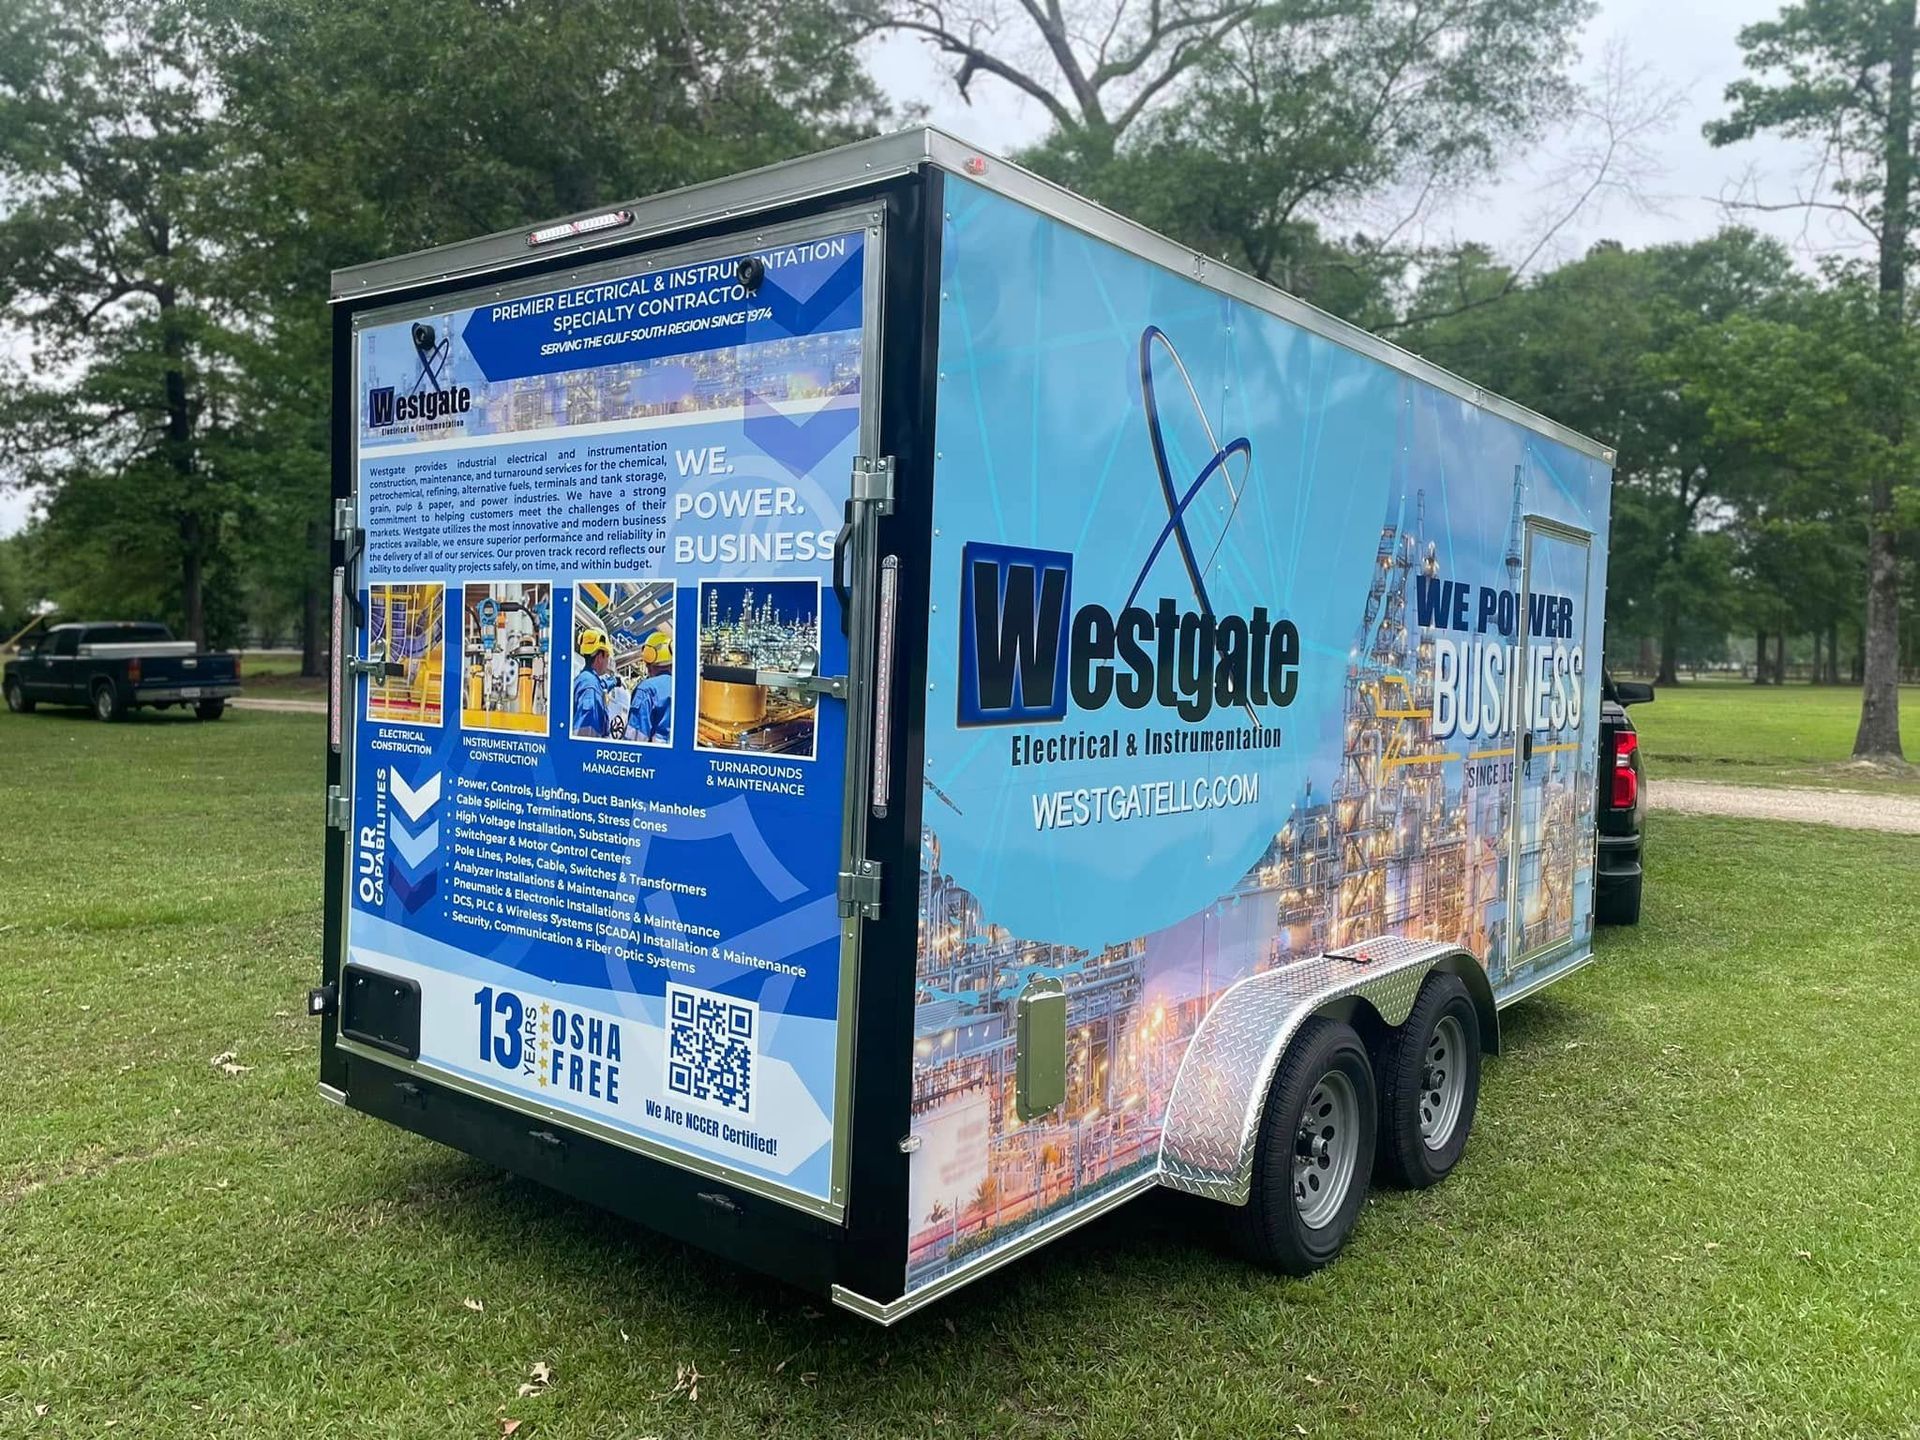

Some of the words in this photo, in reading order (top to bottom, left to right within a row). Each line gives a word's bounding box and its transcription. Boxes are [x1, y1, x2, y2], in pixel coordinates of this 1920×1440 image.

[492, 297, 554, 322] PREMIER
[558, 278, 650, 309] ELECTRICAL
[653, 275, 664, 291] &
[669, 238, 844, 288] INSTRUNTATION
[540, 338, 582, 355] SERVING
[582, 335, 602, 348] THE
[602, 330, 630, 345] GULF
[630, 324, 667, 341] SOUTH
[667, 317, 710, 335] REGION
[710, 311, 745, 327] SINCE
[746, 306, 772, 322] 1974
[553, 303, 634, 331] SPECIALTY
[371, 386, 471, 427] Westgate
[369, 466, 405, 477] Westgate
[414, 461, 447, 474] provides
[457, 455, 496, 468] industrial
[506, 451, 547, 464] electrical
[557, 448, 575, 459] and
[587, 440, 667, 456] instrumentation
[369, 476, 418, 488] construction,
[419, 473, 474, 484] maintenance,
[475, 469, 491, 480] and
[493, 465, 543, 478] turnaround
[544, 462, 582, 474] services
[584, 461, 597, 471] for
[600, 460, 616, 470] the
[618, 454, 666, 468] chemical,
[675, 446, 734, 476] WE.
[369, 488, 424, 502] petrochemical,
[426, 485, 459, 497] refining,
[461, 481, 506, 494] alternative
[508, 480, 532, 490] fuels,
[534, 476, 577, 488] terminals
[579, 474, 597, 485] and
[600, 472, 622, 484] tank
[625, 471, 666, 482] storage,
[675, 486, 805, 520] POWER.
[369, 539, 402, 551] practices
[404, 538, 440, 547] available,
[456, 537, 484, 546] ensure
[486, 534, 521, 546] superior
[523, 531, 583, 545] performance
[585, 530, 603, 541] and
[606, 528, 653, 541] reliability
[656, 528, 665, 538] in
[370, 527, 400, 537] markets.
[402, 526, 440, 537] Westgate
[442, 523, 470, 534] utilizes
[472, 523, 486, 532] the
[488, 522, 509, 531] most
[512, 518, 558, 530] innovative
[561, 517, 579, 528] and
[581, 516, 619, 527] modern
[622, 515, 666, 525] business
[368, 564, 391, 575] ability
[392, 565, 401, 573] to
[402, 563, 428, 572] deliver
[429, 562, 456, 574] quality
[458, 561, 491, 573] projects
[492, 560, 519, 572] safely,
[521, 562, 533, 570] on
[535, 559, 558, 571] time,
[560, 559, 578, 569] and
[580, 558, 611, 569] within
[613, 558, 652, 570] budget.
[674, 530, 837, 564] BUSINESS
[1416, 575, 1470, 632] WE
[968, 556, 1300, 723] Westgate
[371, 740, 432, 756] CONSTRUCTION
[379, 728, 425, 742] ELECTRICAL
[462, 736, 546, 754] INSTRUMENTATION
[1012, 729, 1118, 766] Electrical
[1126, 731, 1138, 756] &
[1145, 725, 1282, 756] Instrumentation
[469, 750, 538, 766] CONSTRUCTION
[582, 762, 656, 780] MANAGEMENT
[596, 749, 642, 764] PROJECT
[709, 760, 803, 780] TURNAROUNDS
[1468, 764, 1498, 788] SINCE
[1502, 761, 1531, 782] 194
[457, 776, 489, 791] Power,
[490, 780, 533, 797] Controls,
[535, 785, 580, 804] Lighting,
[582, 791, 607, 805] Duct
[610, 795, 646, 812] Banks,
[649, 800, 706, 818] Manholes
[706, 774, 715, 788] &
[718, 775, 805, 796] MAINTENANCE
[1032, 772, 1260, 831] WESTGATELLC.COM
[455, 809, 477, 824] High
[479, 813, 515, 829] Voltage
[517, 819, 576, 839] Installation,
[578, 827, 640, 847] Substations
[456, 793, 482, 806] Cable
[483, 797, 524, 814] Splicing,
[526, 802, 595, 824] Terminations,
[597, 812, 630, 827] Stress
[632, 817, 667, 832] Cones
[374, 768, 386, 906] CAPABILITIES
[454, 826, 507, 844] Switchgear
[508, 835, 516, 846] &
[518, 836, 548, 850] Motor
[550, 841, 588, 857] Control
[590, 848, 631, 865] Centers
[360, 826, 377, 902] OUR
[453, 860, 493, 876] Analyzer
[495, 868, 555, 888] Installations
[557, 879, 564, 889] &
[566, 881, 635, 903] Maintenance
[454, 843, 474, 856] Pole
[476, 847, 503, 863] Lines,
[505, 852, 534, 868] Poles,
[536, 857, 567, 874] Cable,
[569, 863, 616, 881] Switches
[618, 871, 626, 882] &
[628, 872, 706, 896] Transformers
[453, 876, 503, 895] Pneumatic
[504, 887, 512, 897] &
[514, 888, 564, 907] Electronic
[566, 898, 630, 921] Installations
[633, 911, 641, 923] &
[644, 913, 720, 938] Maintenance
[452, 893, 474, 909] DCS,
[476, 898, 494, 911] PLC
[496, 902, 503, 913] &
[505, 904, 548, 922] Wireless
[550, 913, 592, 931] Systems
[595, 922, 640, 944] (SCADA)
[643, 932, 708, 956] Installation
[711, 946, 719, 958] &
[723, 949, 806, 977] Maintenance
[452, 910, 492, 930] Security,
[494, 919, 573, 946] Communication
[575, 936, 583, 947] &
[585, 938, 612, 954] Fiber
[614, 945, 644, 961] Optic
[646, 952, 695, 973] Systems
[474, 986, 524, 1070] 13
[523, 1006, 537, 1077] YEARS
[552, 1008, 622, 1062] OSHA
[551, 1049, 620, 1105] FREE
[645, 1099, 661, 1118] We
[664, 1105, 682, 1125] Are
[685, 1112, 719, 1137] NCCER
[722, 1124, 776, 1156] Certified!
